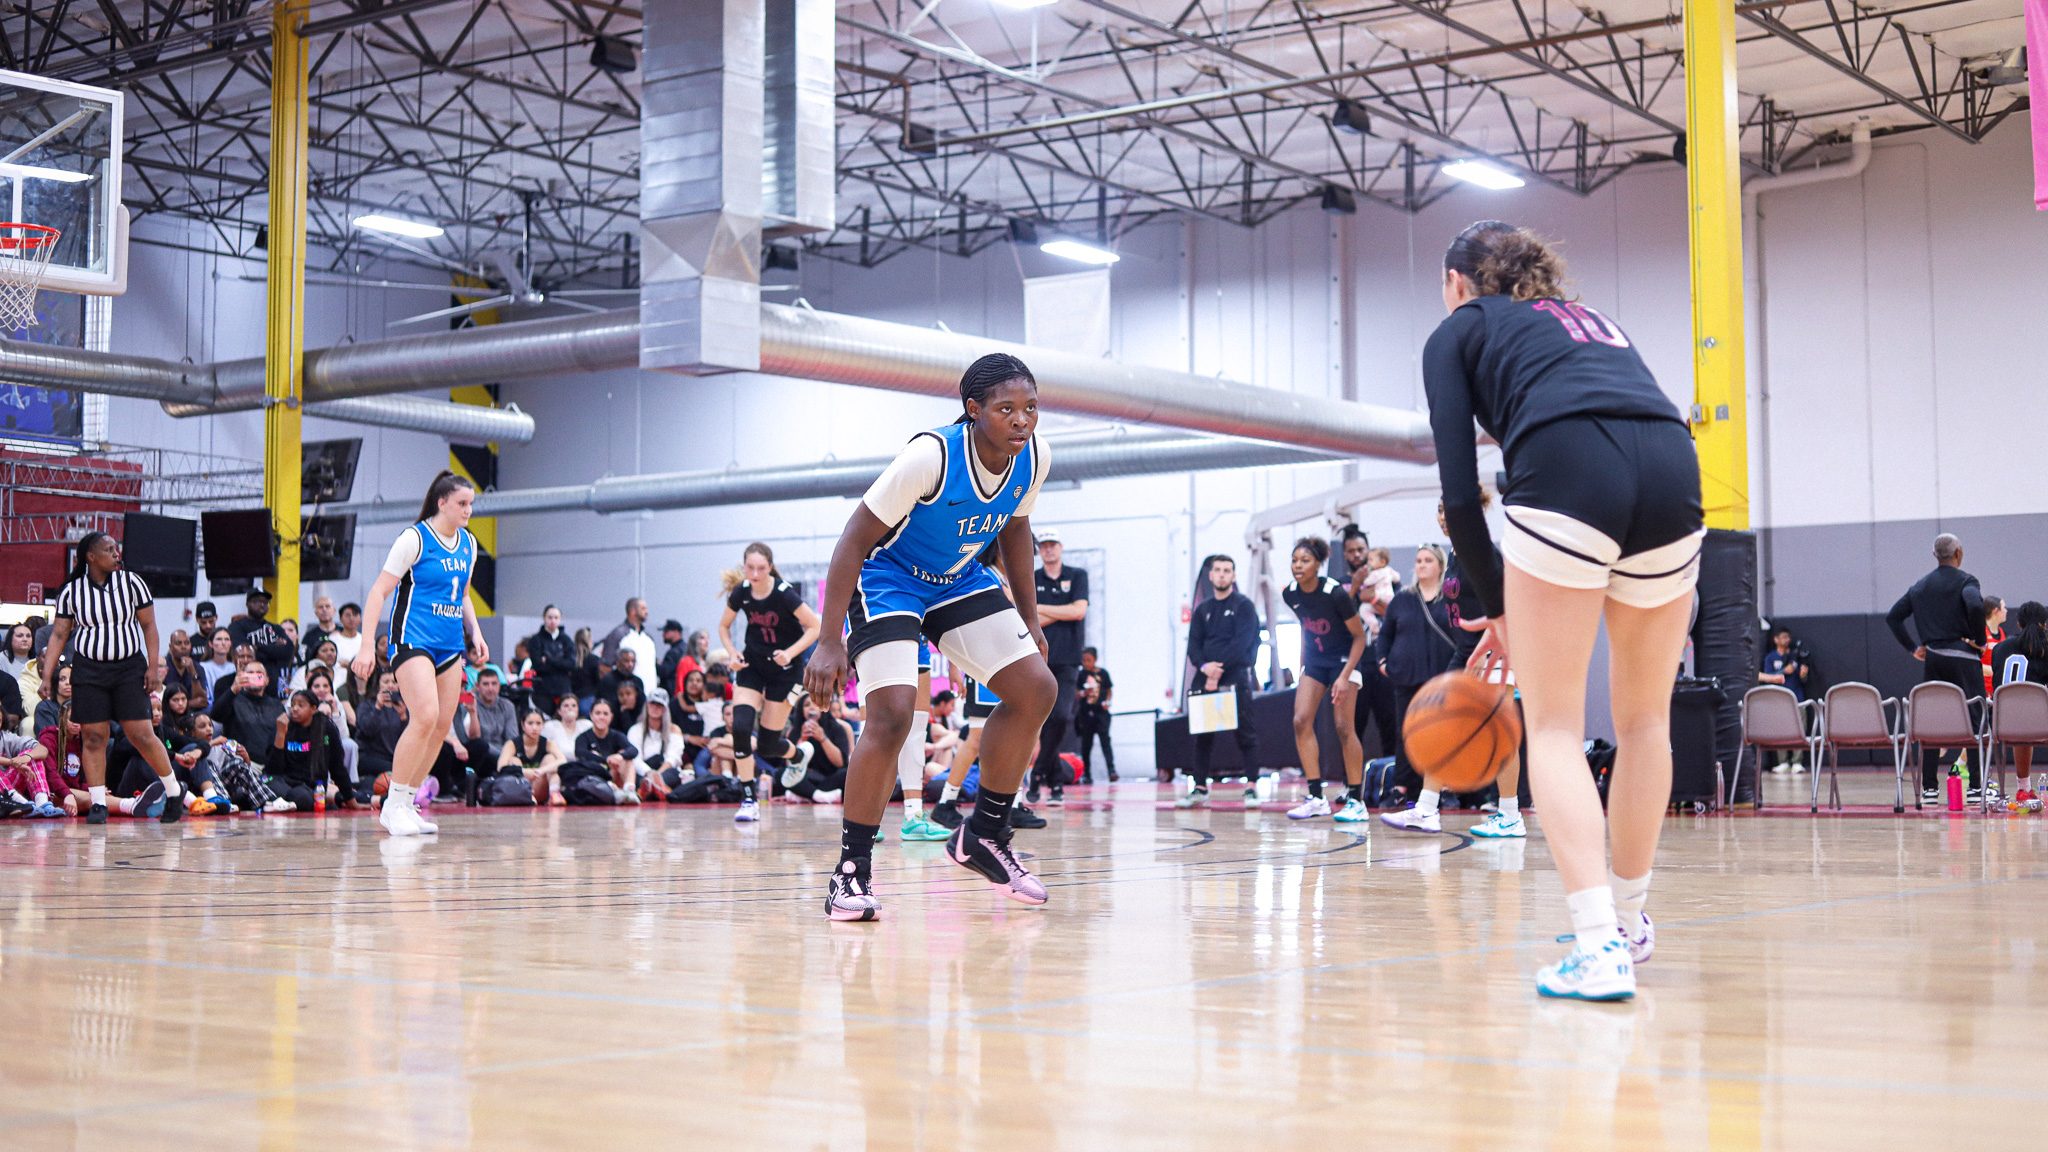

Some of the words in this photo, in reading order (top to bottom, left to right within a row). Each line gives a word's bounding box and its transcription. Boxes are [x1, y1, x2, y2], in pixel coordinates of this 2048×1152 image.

[1531, 299, 1630, 349] 10
[957, 513, 1009, 537] TEAM
[440, 558, 467, 573] TEAM
[943, 541, 985, 575] 7
[451, 576, 459, 602] 1
[760, 627, 777, 644] 11
